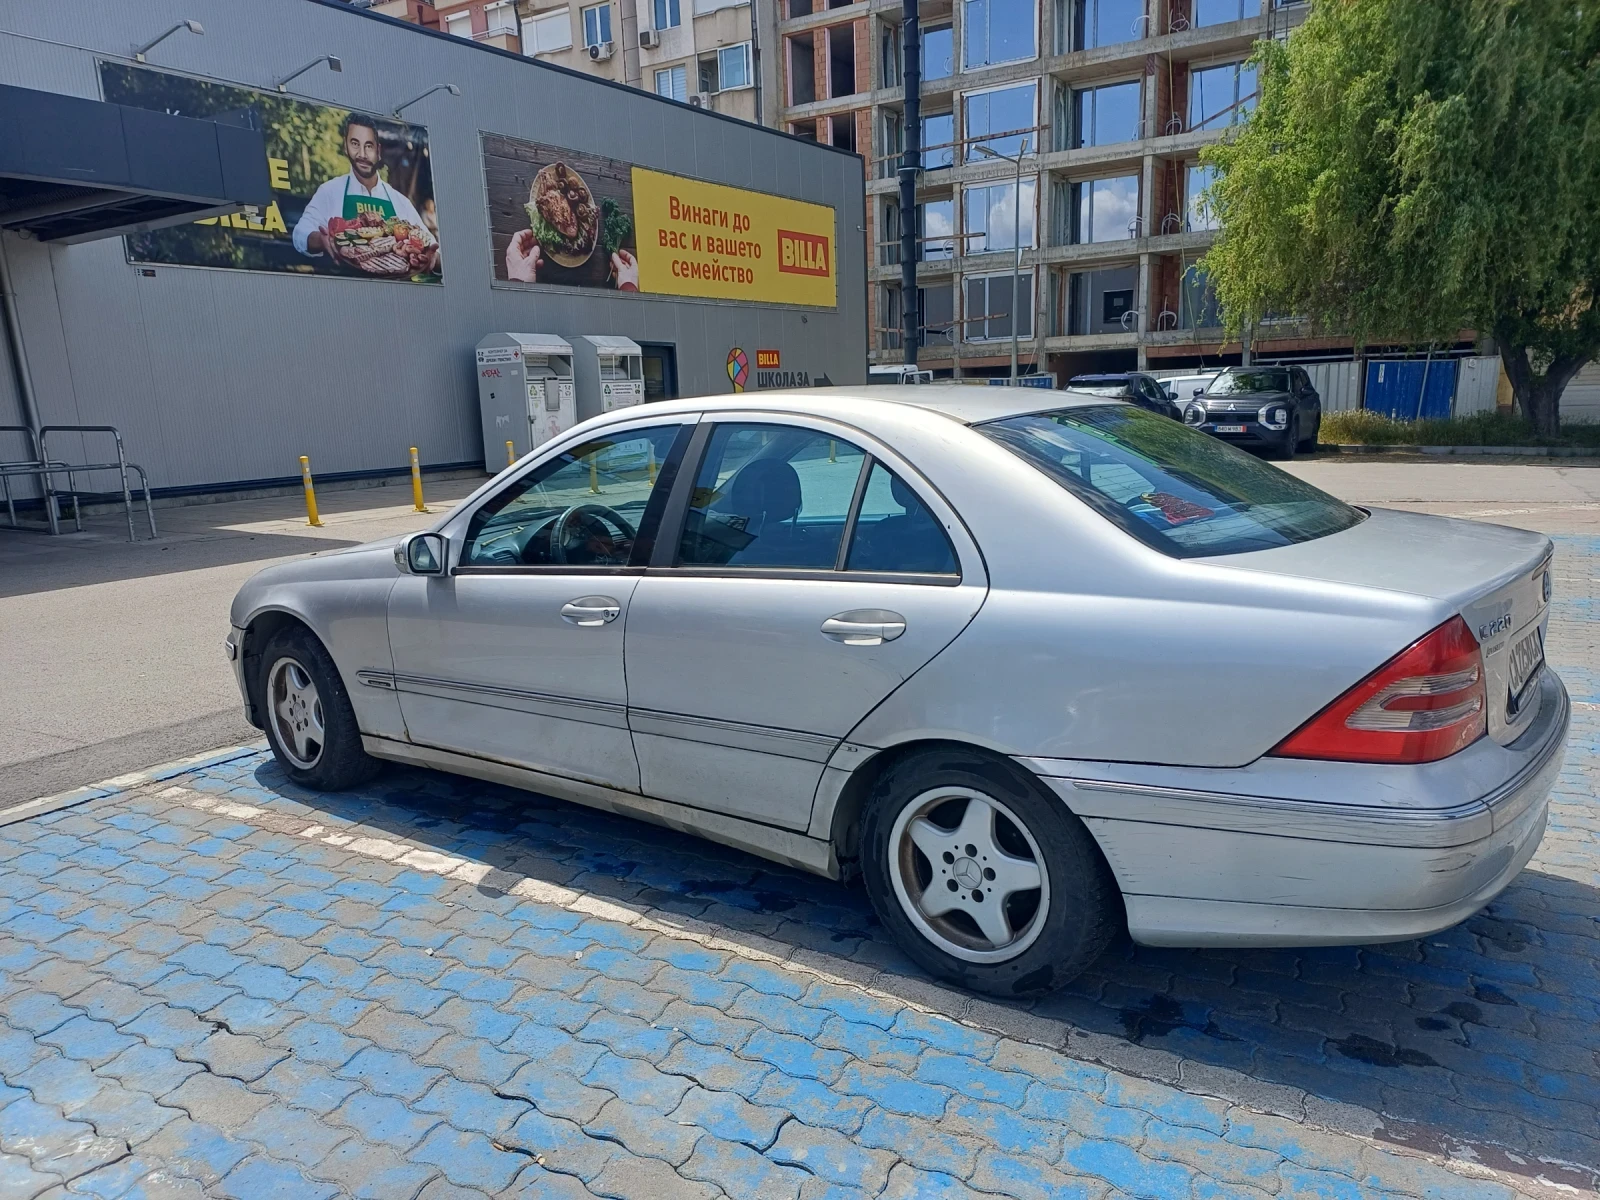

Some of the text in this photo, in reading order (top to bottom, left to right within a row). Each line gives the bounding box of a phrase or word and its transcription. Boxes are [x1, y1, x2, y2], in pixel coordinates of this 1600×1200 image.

[356, 202, 386, 217] BILLA
[669, 195, 751, 234] Винаги до
[658, 228, 762, 259] вас и вашето
[781, 237, 827, 271] BILLA
[671, 259, 754, 285] семейство
[758, 353, 779, 365] BILLA
